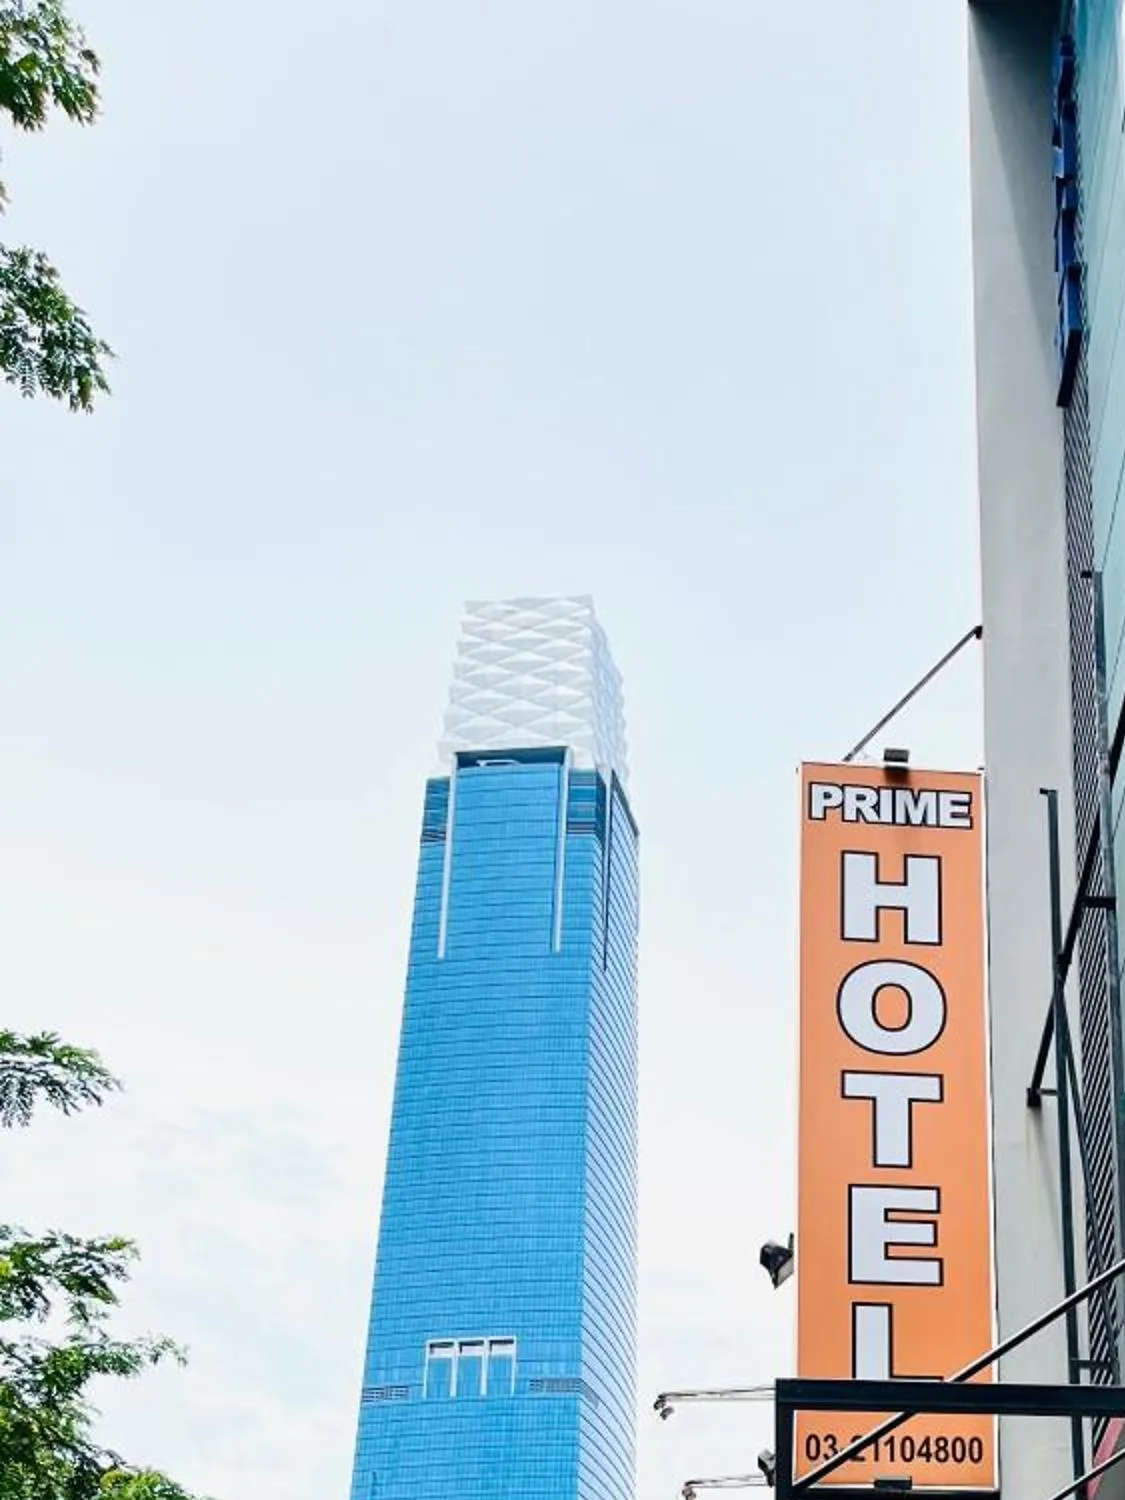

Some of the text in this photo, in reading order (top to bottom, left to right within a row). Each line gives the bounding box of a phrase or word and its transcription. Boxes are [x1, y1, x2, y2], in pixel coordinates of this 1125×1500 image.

[808, 781, 973, 829] PRIME
[836, 850, 947, 1384] HOTEL
[806, 1433, 983, 1463] 0321104800
